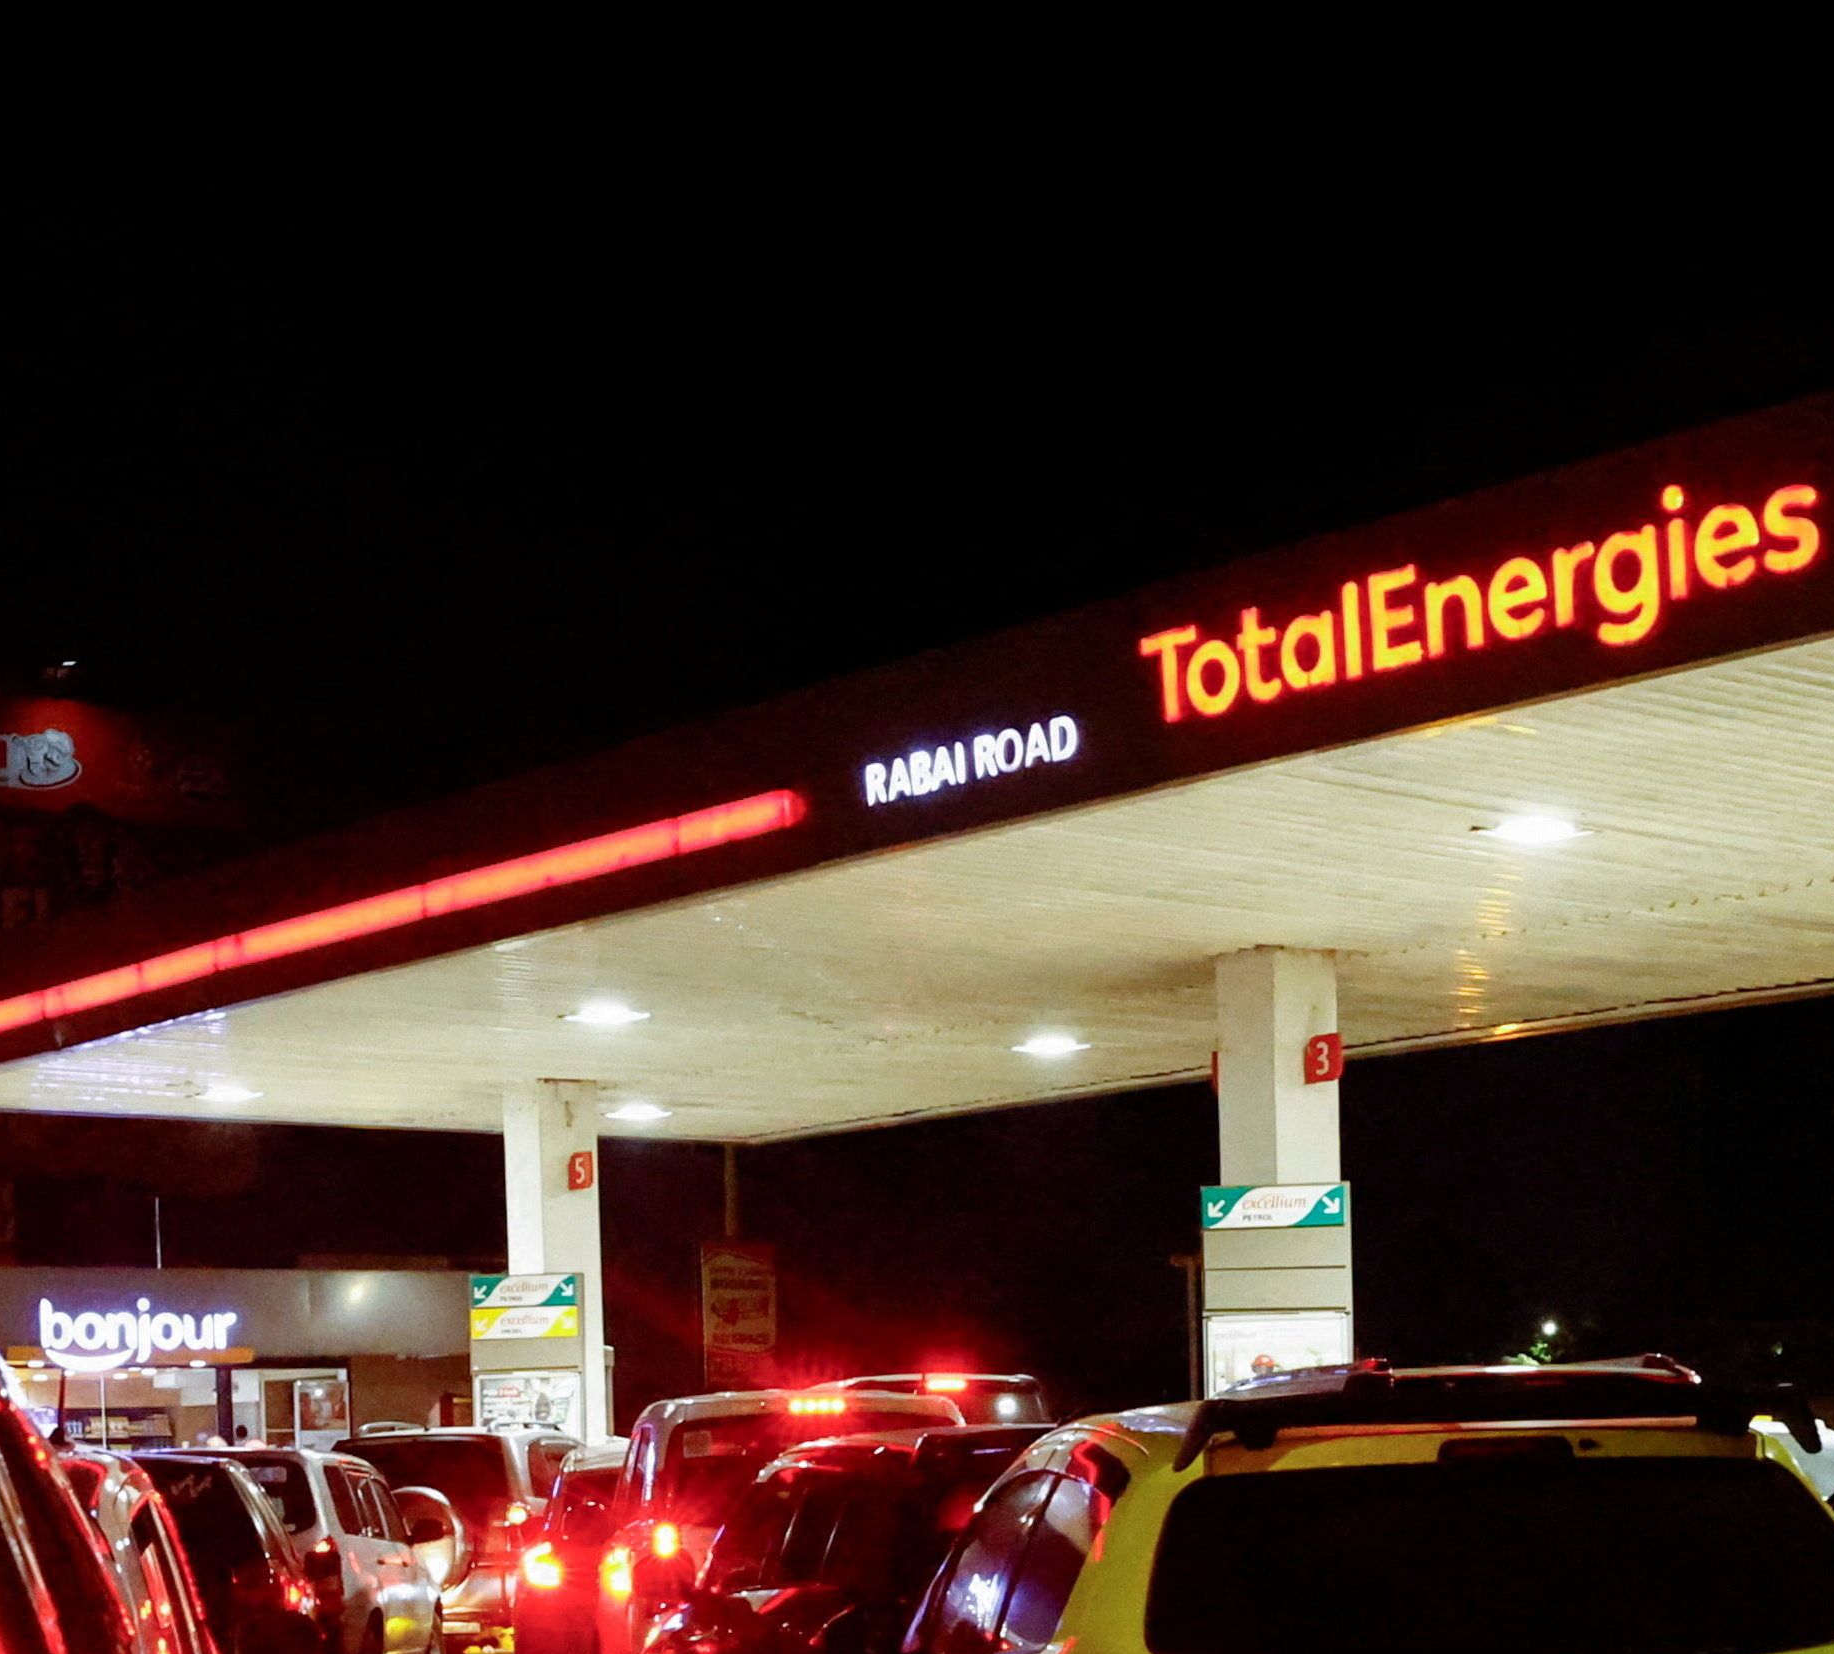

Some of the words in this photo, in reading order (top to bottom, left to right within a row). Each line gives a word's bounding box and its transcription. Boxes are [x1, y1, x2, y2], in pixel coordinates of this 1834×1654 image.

[1140, 484, 1820, 723] TotalEnergies
[865, 741, 966, 807] RABAI
[973, 715, 1079, 780] ROAD
[1315, 1041, 1330, 1076] 3
[574, 1157, 586, 1185] 5
[1241, 1193, 1307, 1211] excellium
[39, 1298, 237, 1363] bonjour
